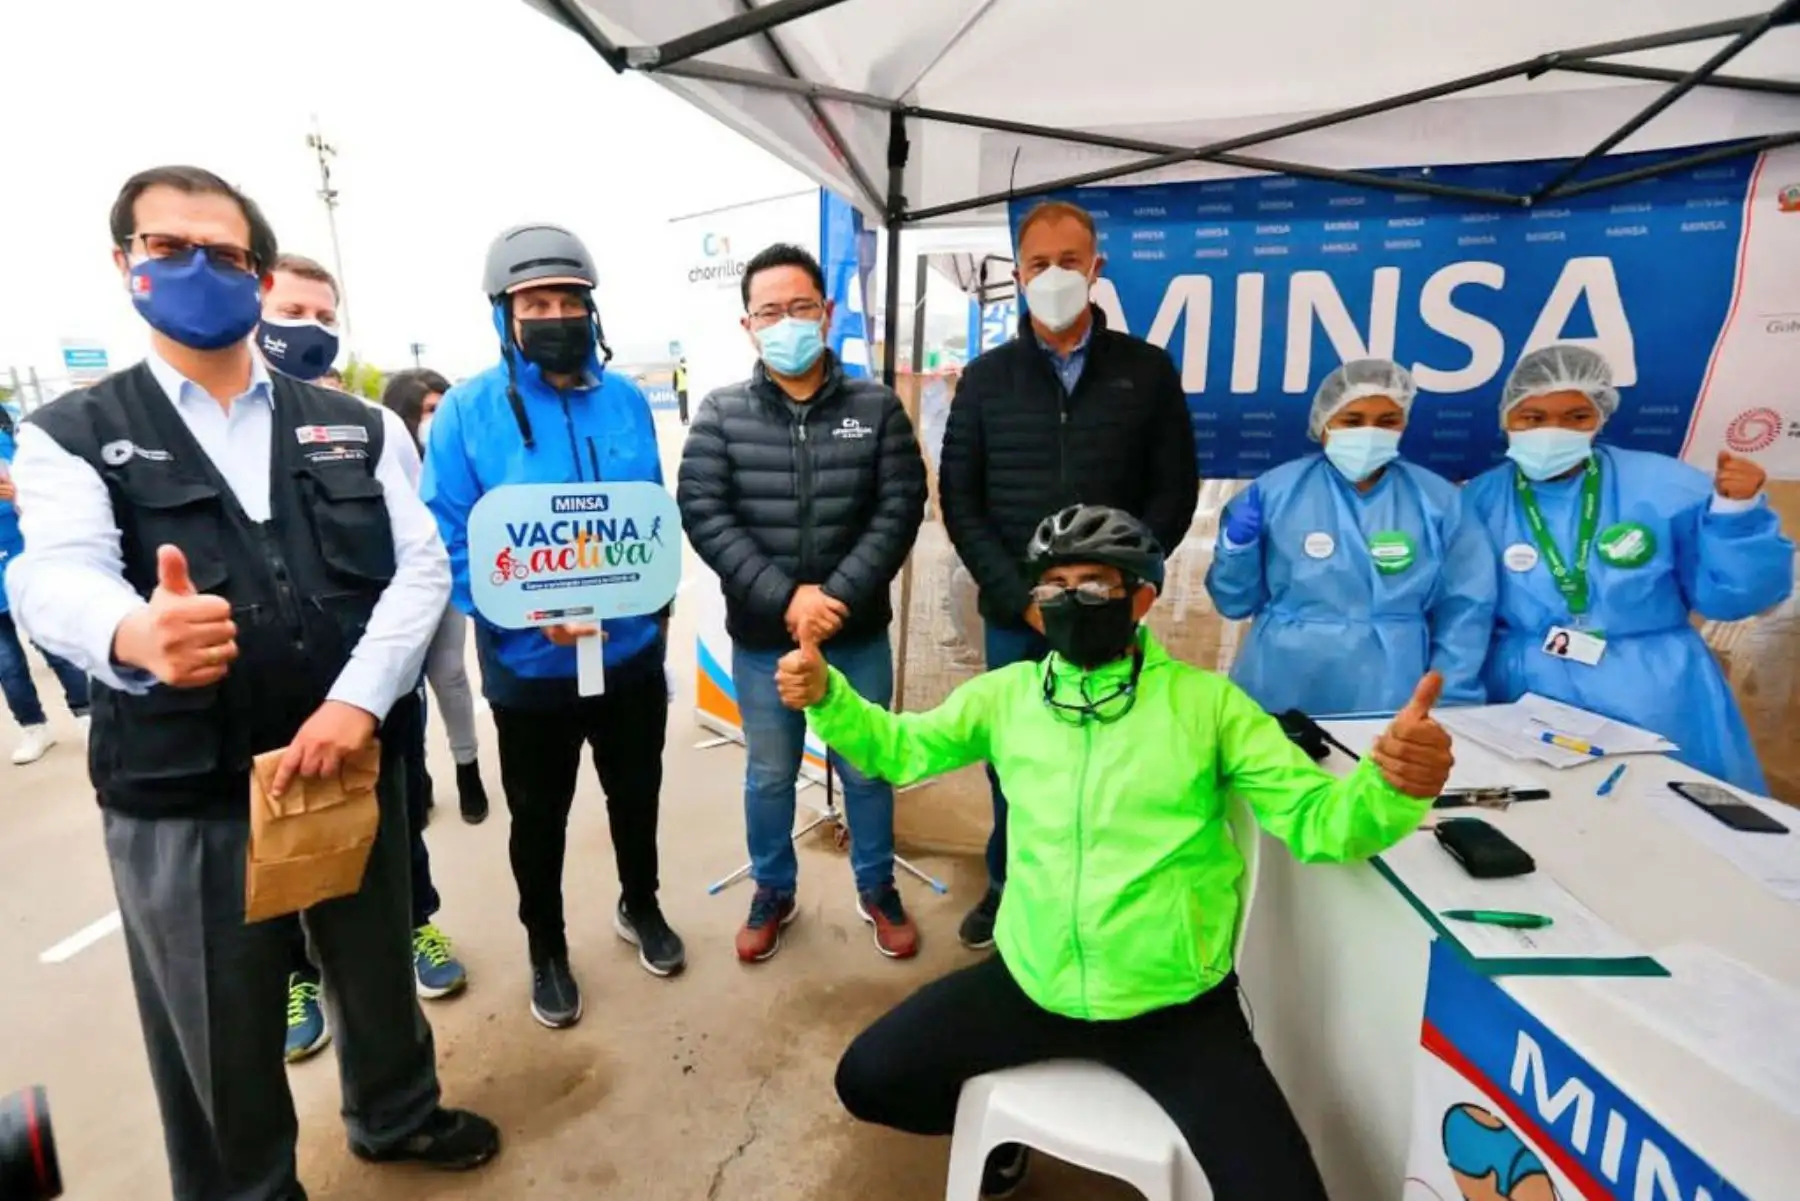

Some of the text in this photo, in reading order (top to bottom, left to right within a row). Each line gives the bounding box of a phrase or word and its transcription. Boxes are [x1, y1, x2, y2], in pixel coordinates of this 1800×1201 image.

[687, 258, 751, 284] chorrillo
[1090, 256, 1638, 394] MINSA
[554, 495, 606, 513] MINSA
[505, 517, 640, 548] VACUNA
[530, 529, 656, 574] activa
